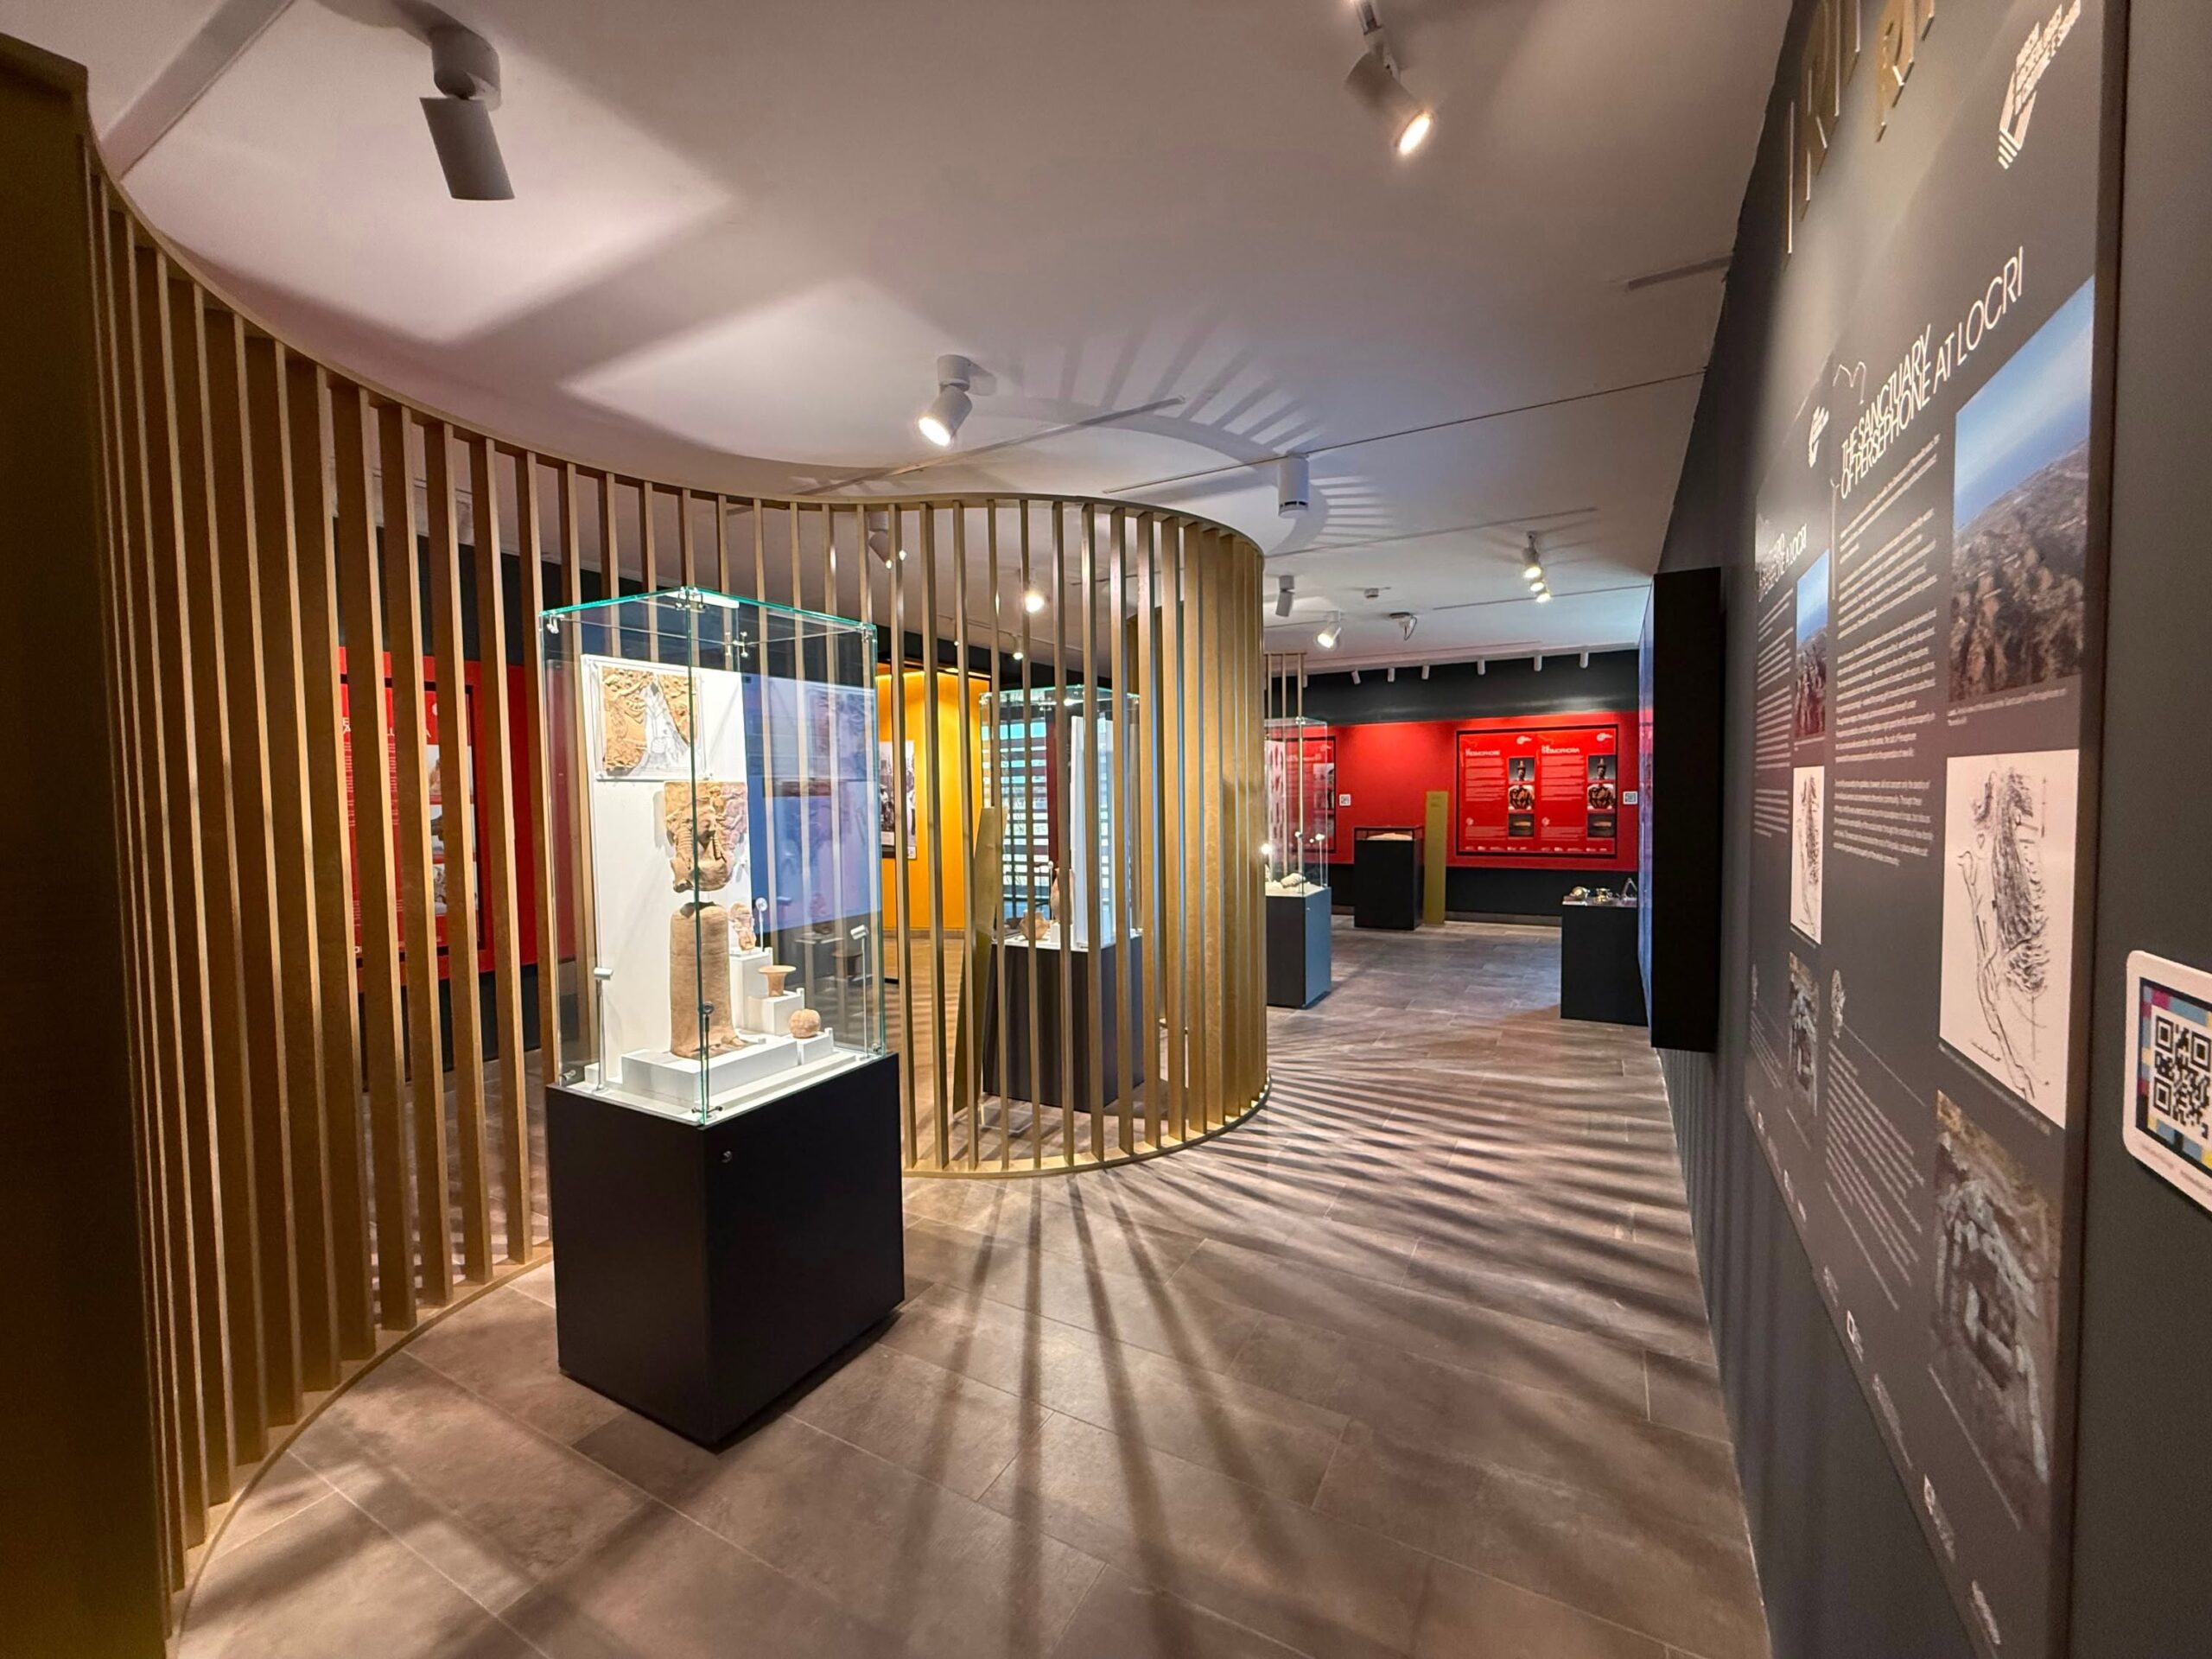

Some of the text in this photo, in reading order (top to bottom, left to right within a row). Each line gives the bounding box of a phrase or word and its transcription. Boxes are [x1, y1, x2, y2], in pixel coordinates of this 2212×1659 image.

[1841, 454, 1855, 499] OF
[1855, 361, 1931, 486] PERSEPHONE
[1933, 332, 1955, 395] AT
[1956, 245, 2024, 366] LOCRI
[1841, 426, 1858, 472] THE
[1859, 323, 1931, 449] SANCTUARY
